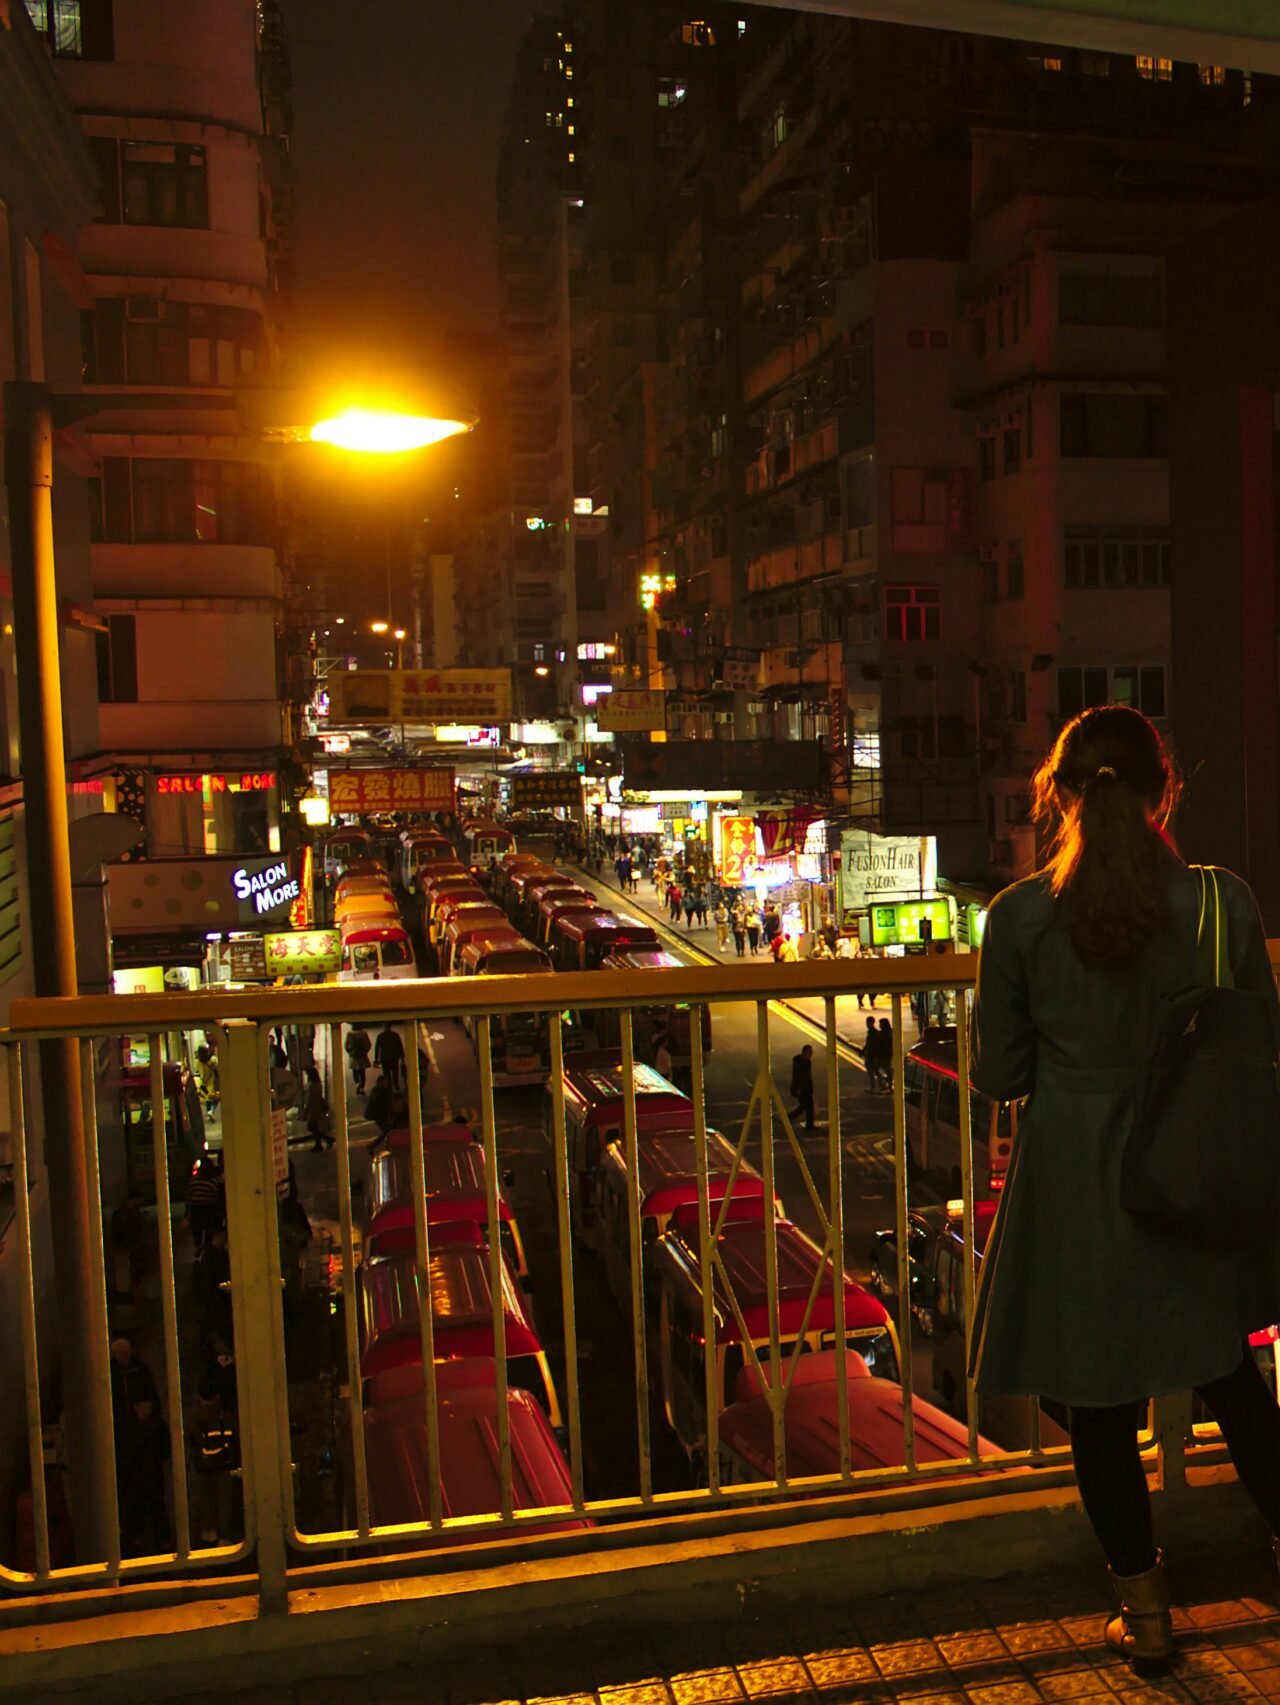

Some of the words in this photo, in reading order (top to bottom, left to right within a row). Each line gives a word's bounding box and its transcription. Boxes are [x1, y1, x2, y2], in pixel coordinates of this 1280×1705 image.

[233, 861, 288, 899] SALON
[865, 875, 897, 889] SALON
[254, 879, 300, 914] MORE
[268, 934, 338, 958] 海天堂
